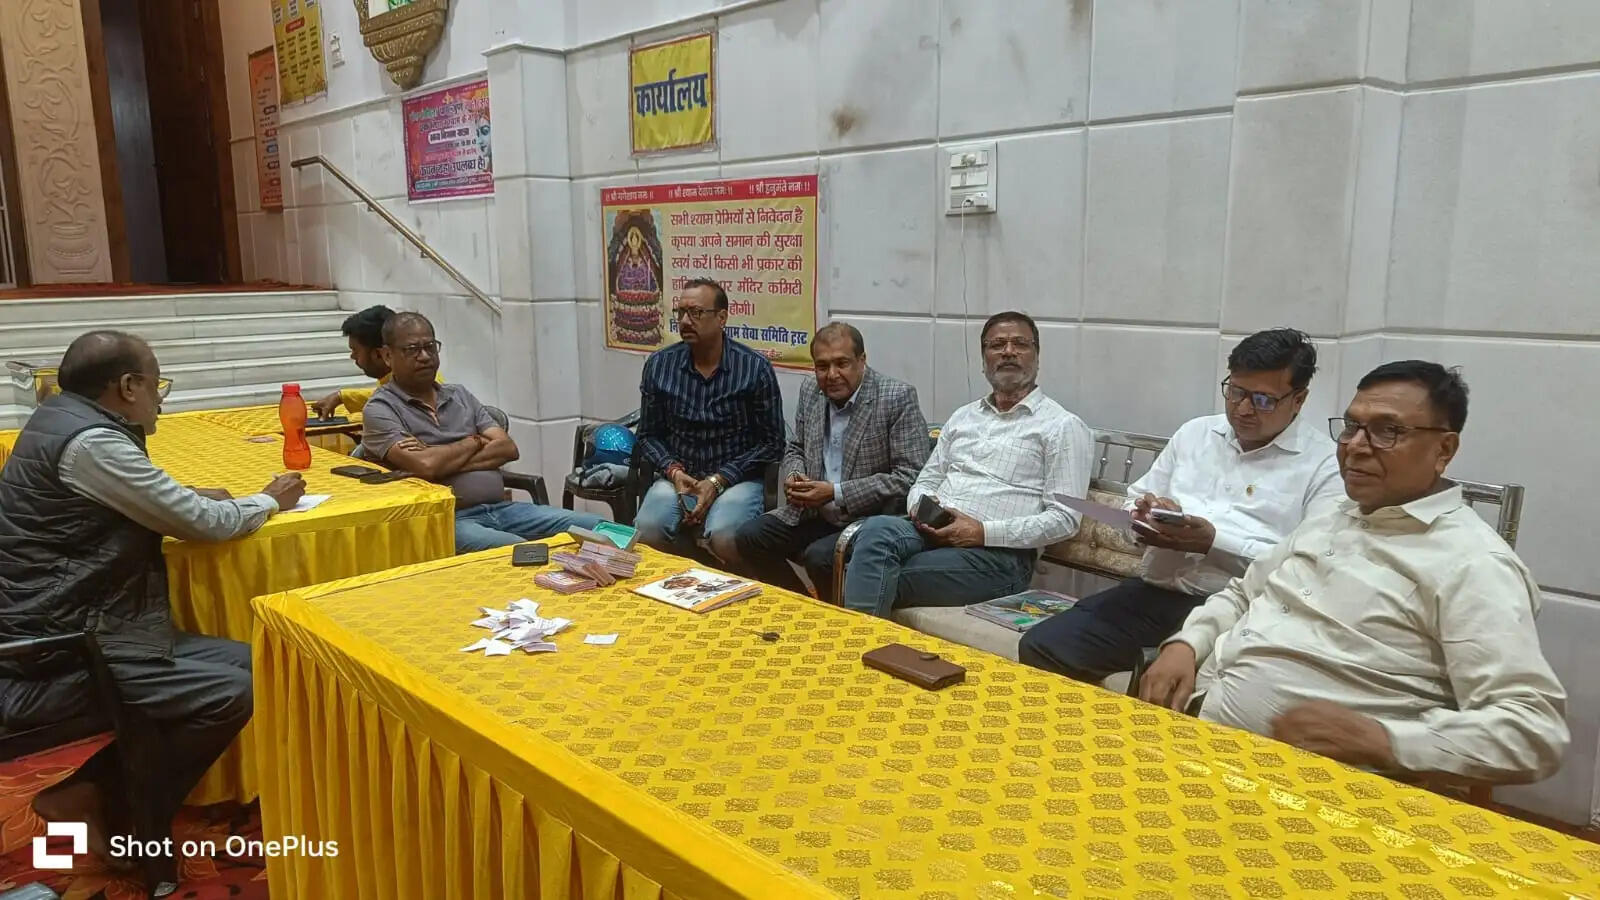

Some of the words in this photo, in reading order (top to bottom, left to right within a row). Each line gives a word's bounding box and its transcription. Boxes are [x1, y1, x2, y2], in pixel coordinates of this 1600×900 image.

[634, 68, 708, 117] कार्यालय
[674, 186, 682, 198] श्री
[755, 180, 764, 193] श्री
[765, 179, 787, 196] हनुमंते
[788, 181, 802, 193] नमः
[671, 210, 689, 225] सभी
[691, 213, 713, 225] श्याम
[715, 207, 744, 226] प्रेमियों
[746, 209, 755, 225] से
[757, 208, 793, 224] निवेदन
[794, 205, 804, 224] है
[671, 235, 696, 251] कृपया
[699, 232, 722, 247] अपने
[725, 235, 753, 247] समान
[756, 231, 770, 247] की
[774, 234, 803, 252] सुरक्षा
[671, 254, 690, 269] स्वयं
[714, 254, 739, 270] किसी
[742, 255, 753, 270] भी
[757, 258, 784, 272] प्रकार
[787, 255, 802, 271] की
[737, 277, 763, 293] मंदिर
[768, 279, 802, 295] कमिटी
[741, 323, 759, 340] सेवा
[760, 325, 789, 343] समिति
[791, 331, 808, 347] ट्रस्ट
